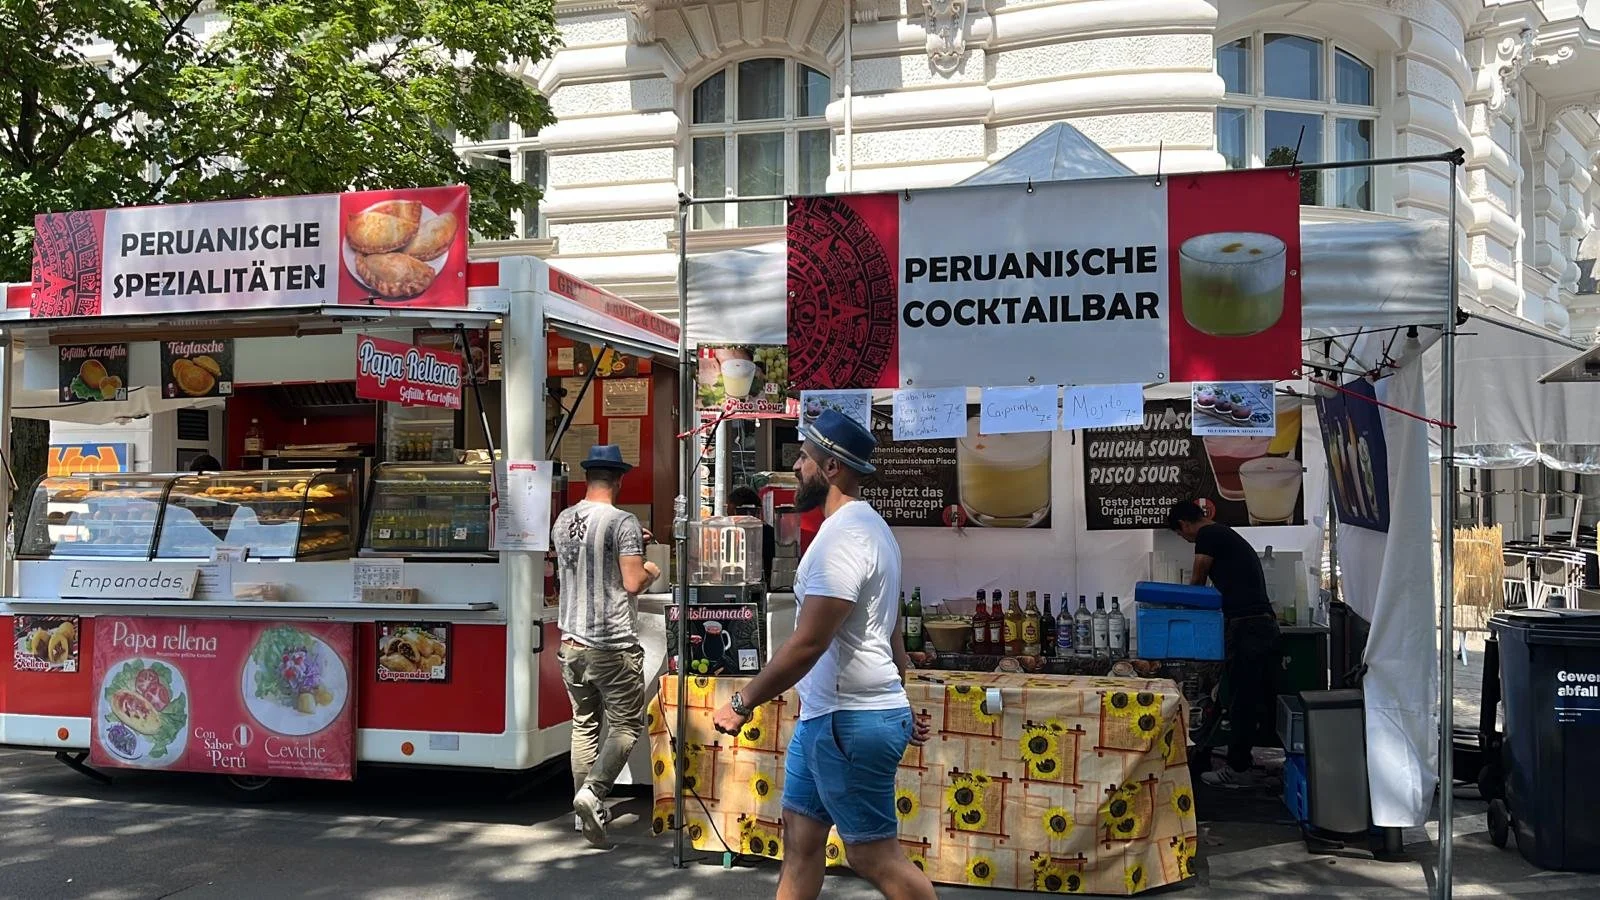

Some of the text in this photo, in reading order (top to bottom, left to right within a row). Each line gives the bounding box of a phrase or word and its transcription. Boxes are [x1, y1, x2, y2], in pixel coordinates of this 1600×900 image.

[120, 222, 320, 258] PERUANISCHE
[904, 245, 1158, 284] PERUANISCHE
[112, 260, 326, 299] SPEZIALITÄTEN
[903, 291, 1160, 328] COCKTAILBAR
[359, 340, 461, 387] Papa Rellena
[425, 389, 461, 407] Kartoffeln
[724, 398, 754, 412] Pisco
[756, 399, 783, 411] Sour
[1072, 392, 1123, 419] Mojito
[871, 446, 956, 454] thentischer Pisco Sour
[1089, 438, 1190, 458] CHICHA SOUR
[883, 458, 935, 466] peruanischem
[1090, 464, 1180, 484] PISCO SOUR
[858, 485, 944, 499] Teste jetzt das
[1098, 496, 1178, 508] Teste jetzt das
[895, 509, 928, 519] Peru!
[1112, 515, 1164, 525] aus Peru!
[70, 569, 183, 593] Empanadas
[668, 606, 753, 622] Mislimonade
[112, 621, 218, 652] Papa rellena
[16, 659, 49, 669] Rellena
[378, 668, 430, 681] Empanadas
[1557, 685, 1599, 697] abfall
[194, 727, 216, 739] Con
[203, 738, 233, 750] Sabor
[264, 736, 326, 760] Ceviche
[212, 750, 247, 768] Perú
